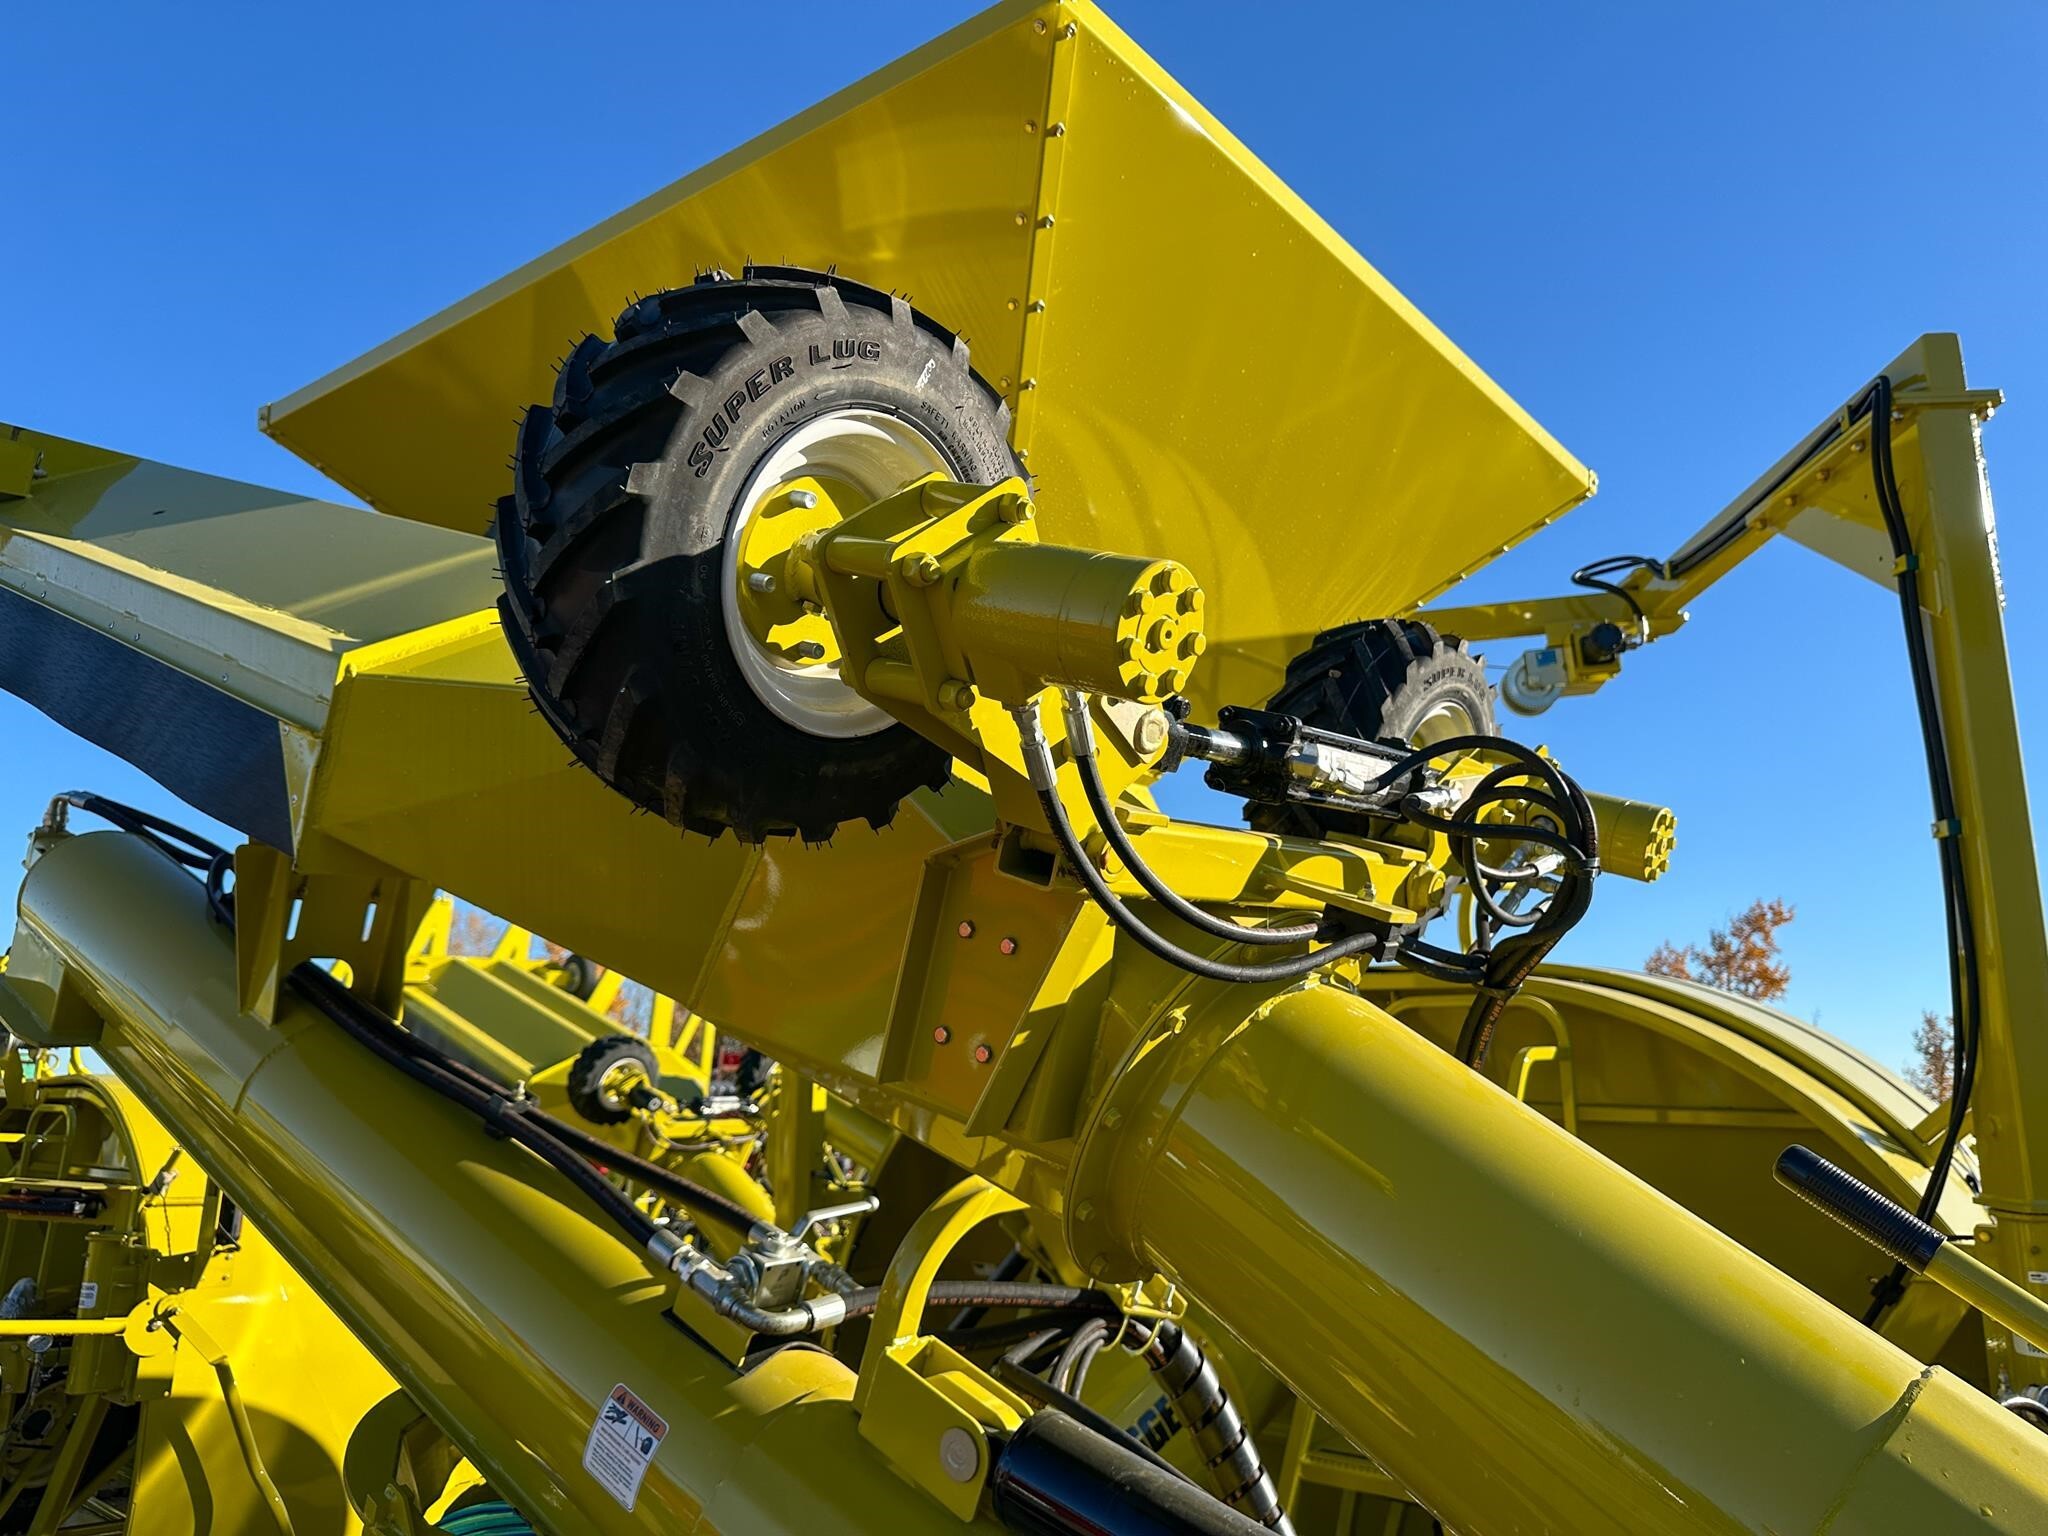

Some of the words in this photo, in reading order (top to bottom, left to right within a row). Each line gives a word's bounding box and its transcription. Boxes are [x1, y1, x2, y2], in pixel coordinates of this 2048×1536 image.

[688, 355, 795, 477] SUPER
[809, 339, 880, 366] LUG
[762, 399, 806, 438] ROTATION
[951, 431, 978, 472] WARNING
[1423, 667, 1465, 692] SUPER
[627, 1399, 660, 1433] WARNING
